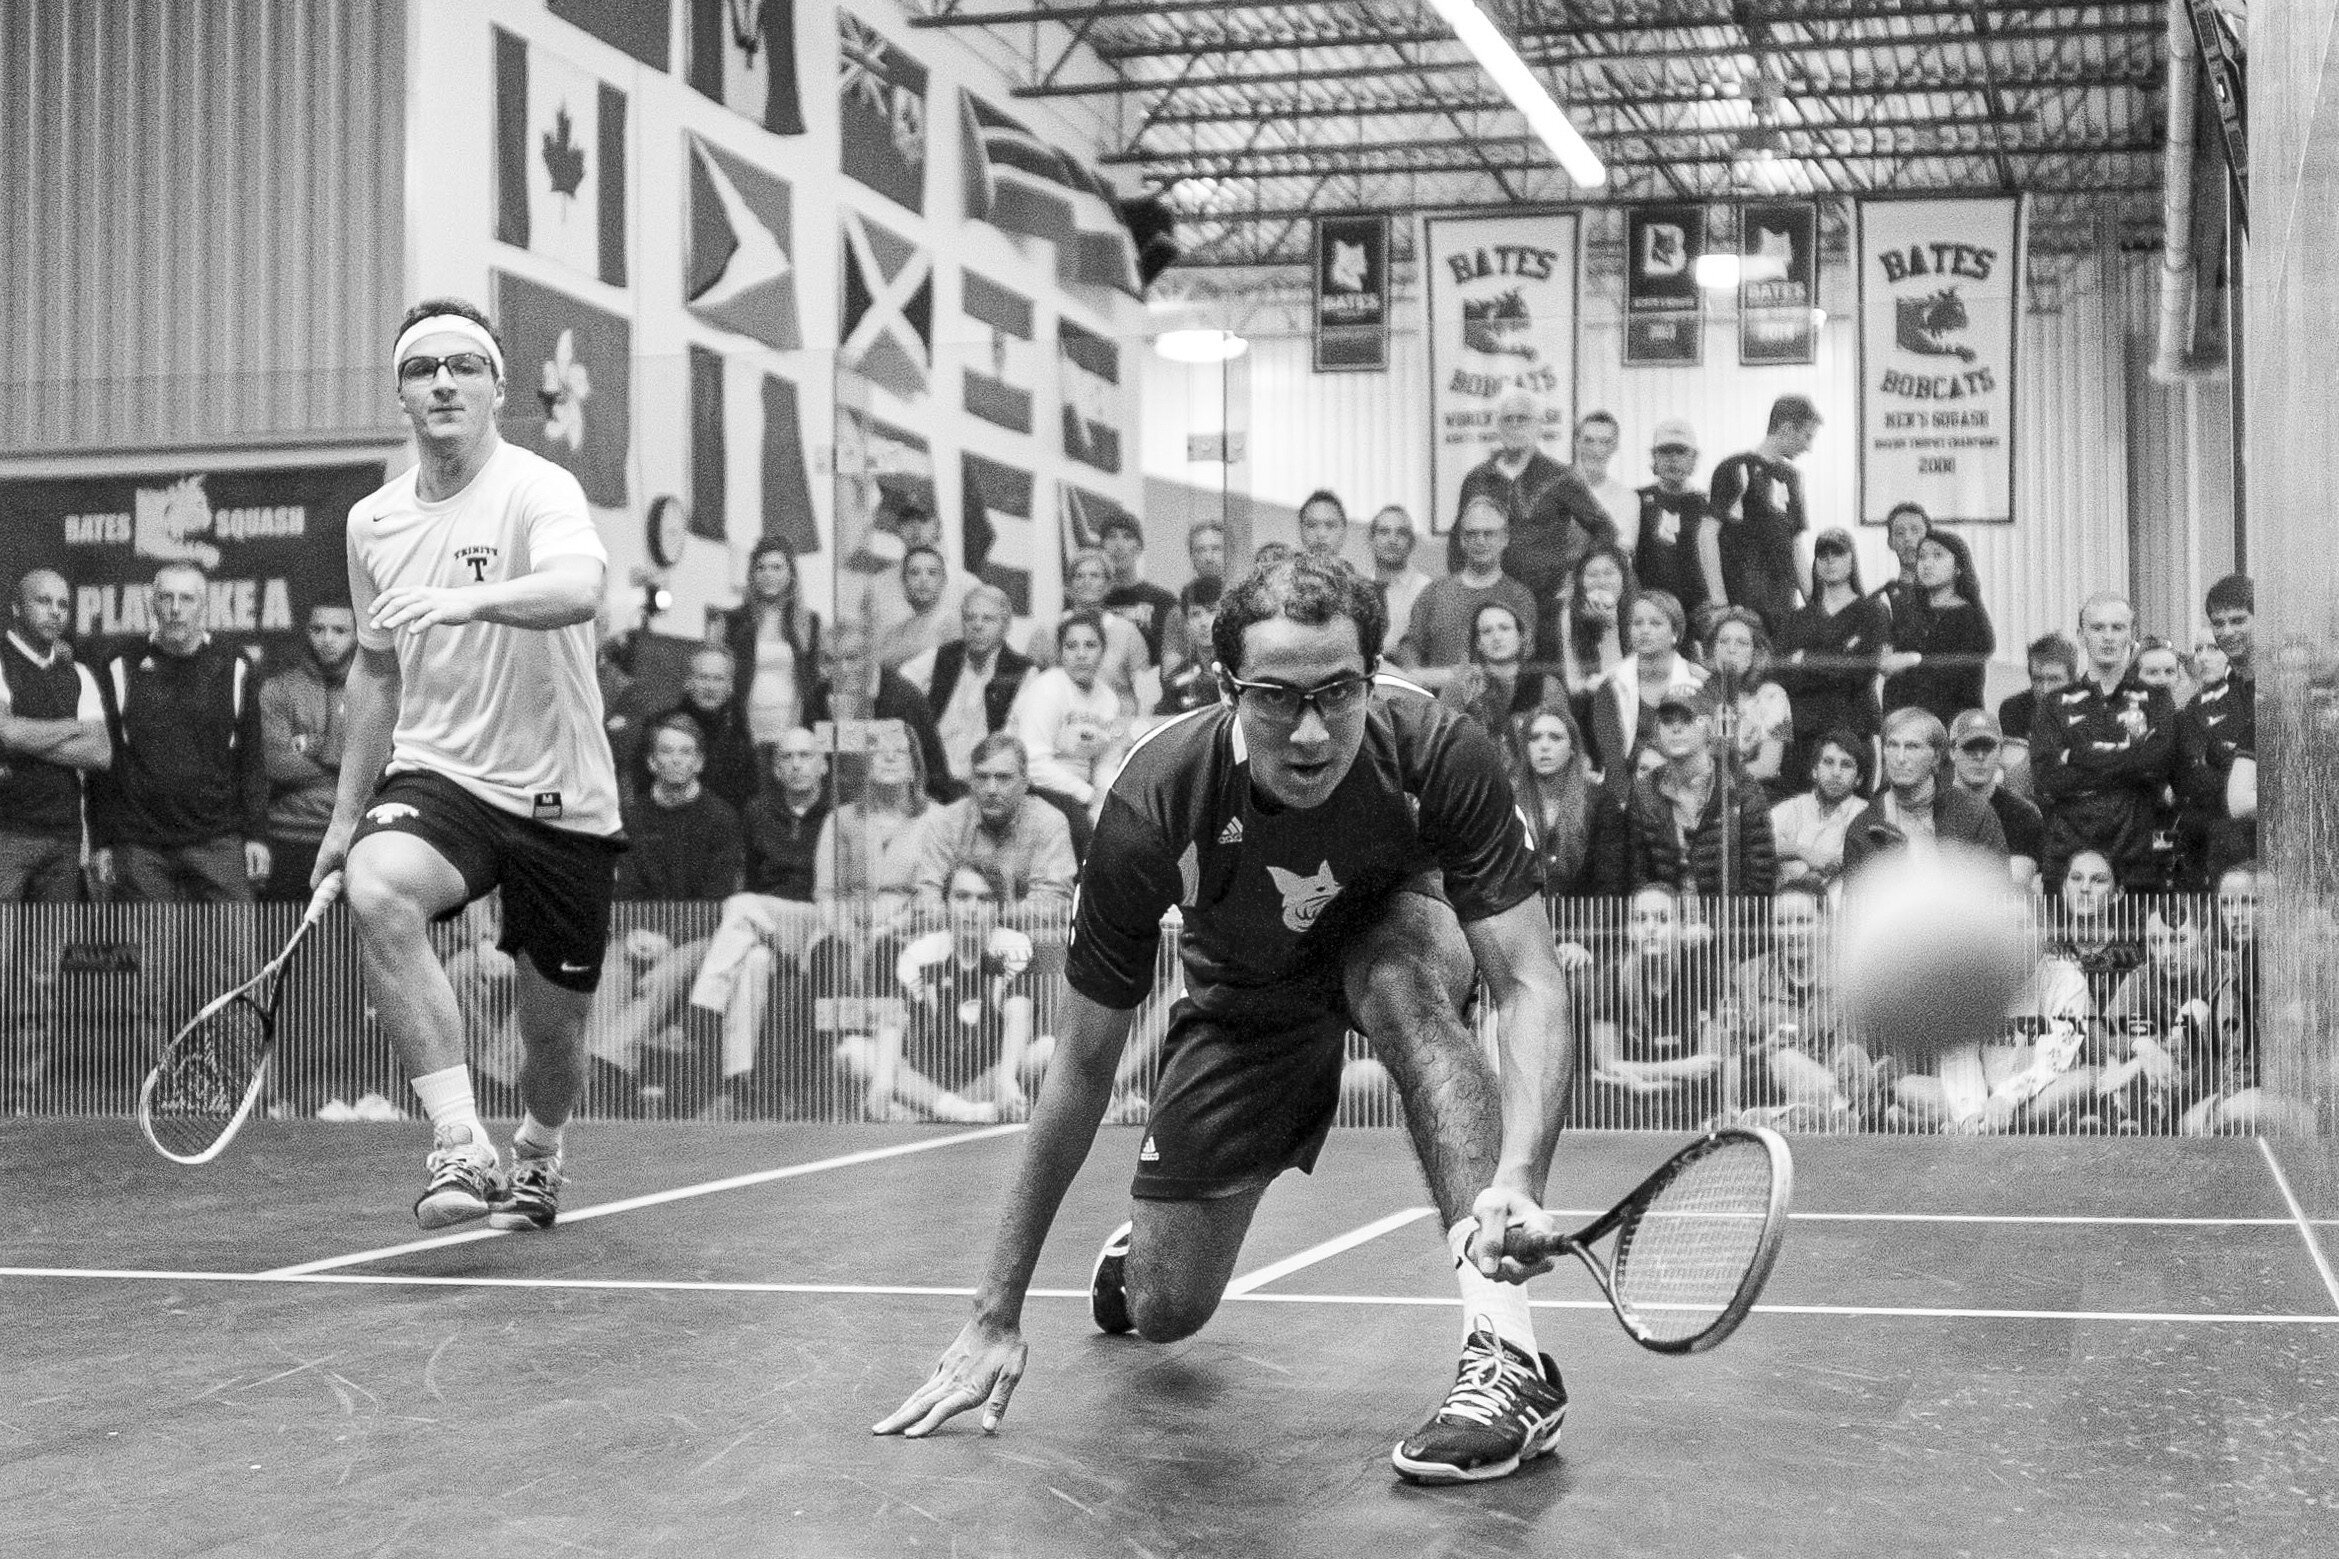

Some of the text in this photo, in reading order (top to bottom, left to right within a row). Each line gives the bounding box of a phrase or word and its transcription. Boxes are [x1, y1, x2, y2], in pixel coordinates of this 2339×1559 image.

[1446, 244, 1558, 284] BATES
[1879, 241, 1997, 282] BATES
[1449, 364, 1557, 397] BOBATS
[1880, 366, 1996, 400] BOBCATS
[1931, 409, 1989, 428] SQUASH
[65, 505, 304, 544] BATES SQUASH
[454, 546, 498, 561] TRINITY
[466, 557, 488, 583] T
[261, 577, 292, 631] A
